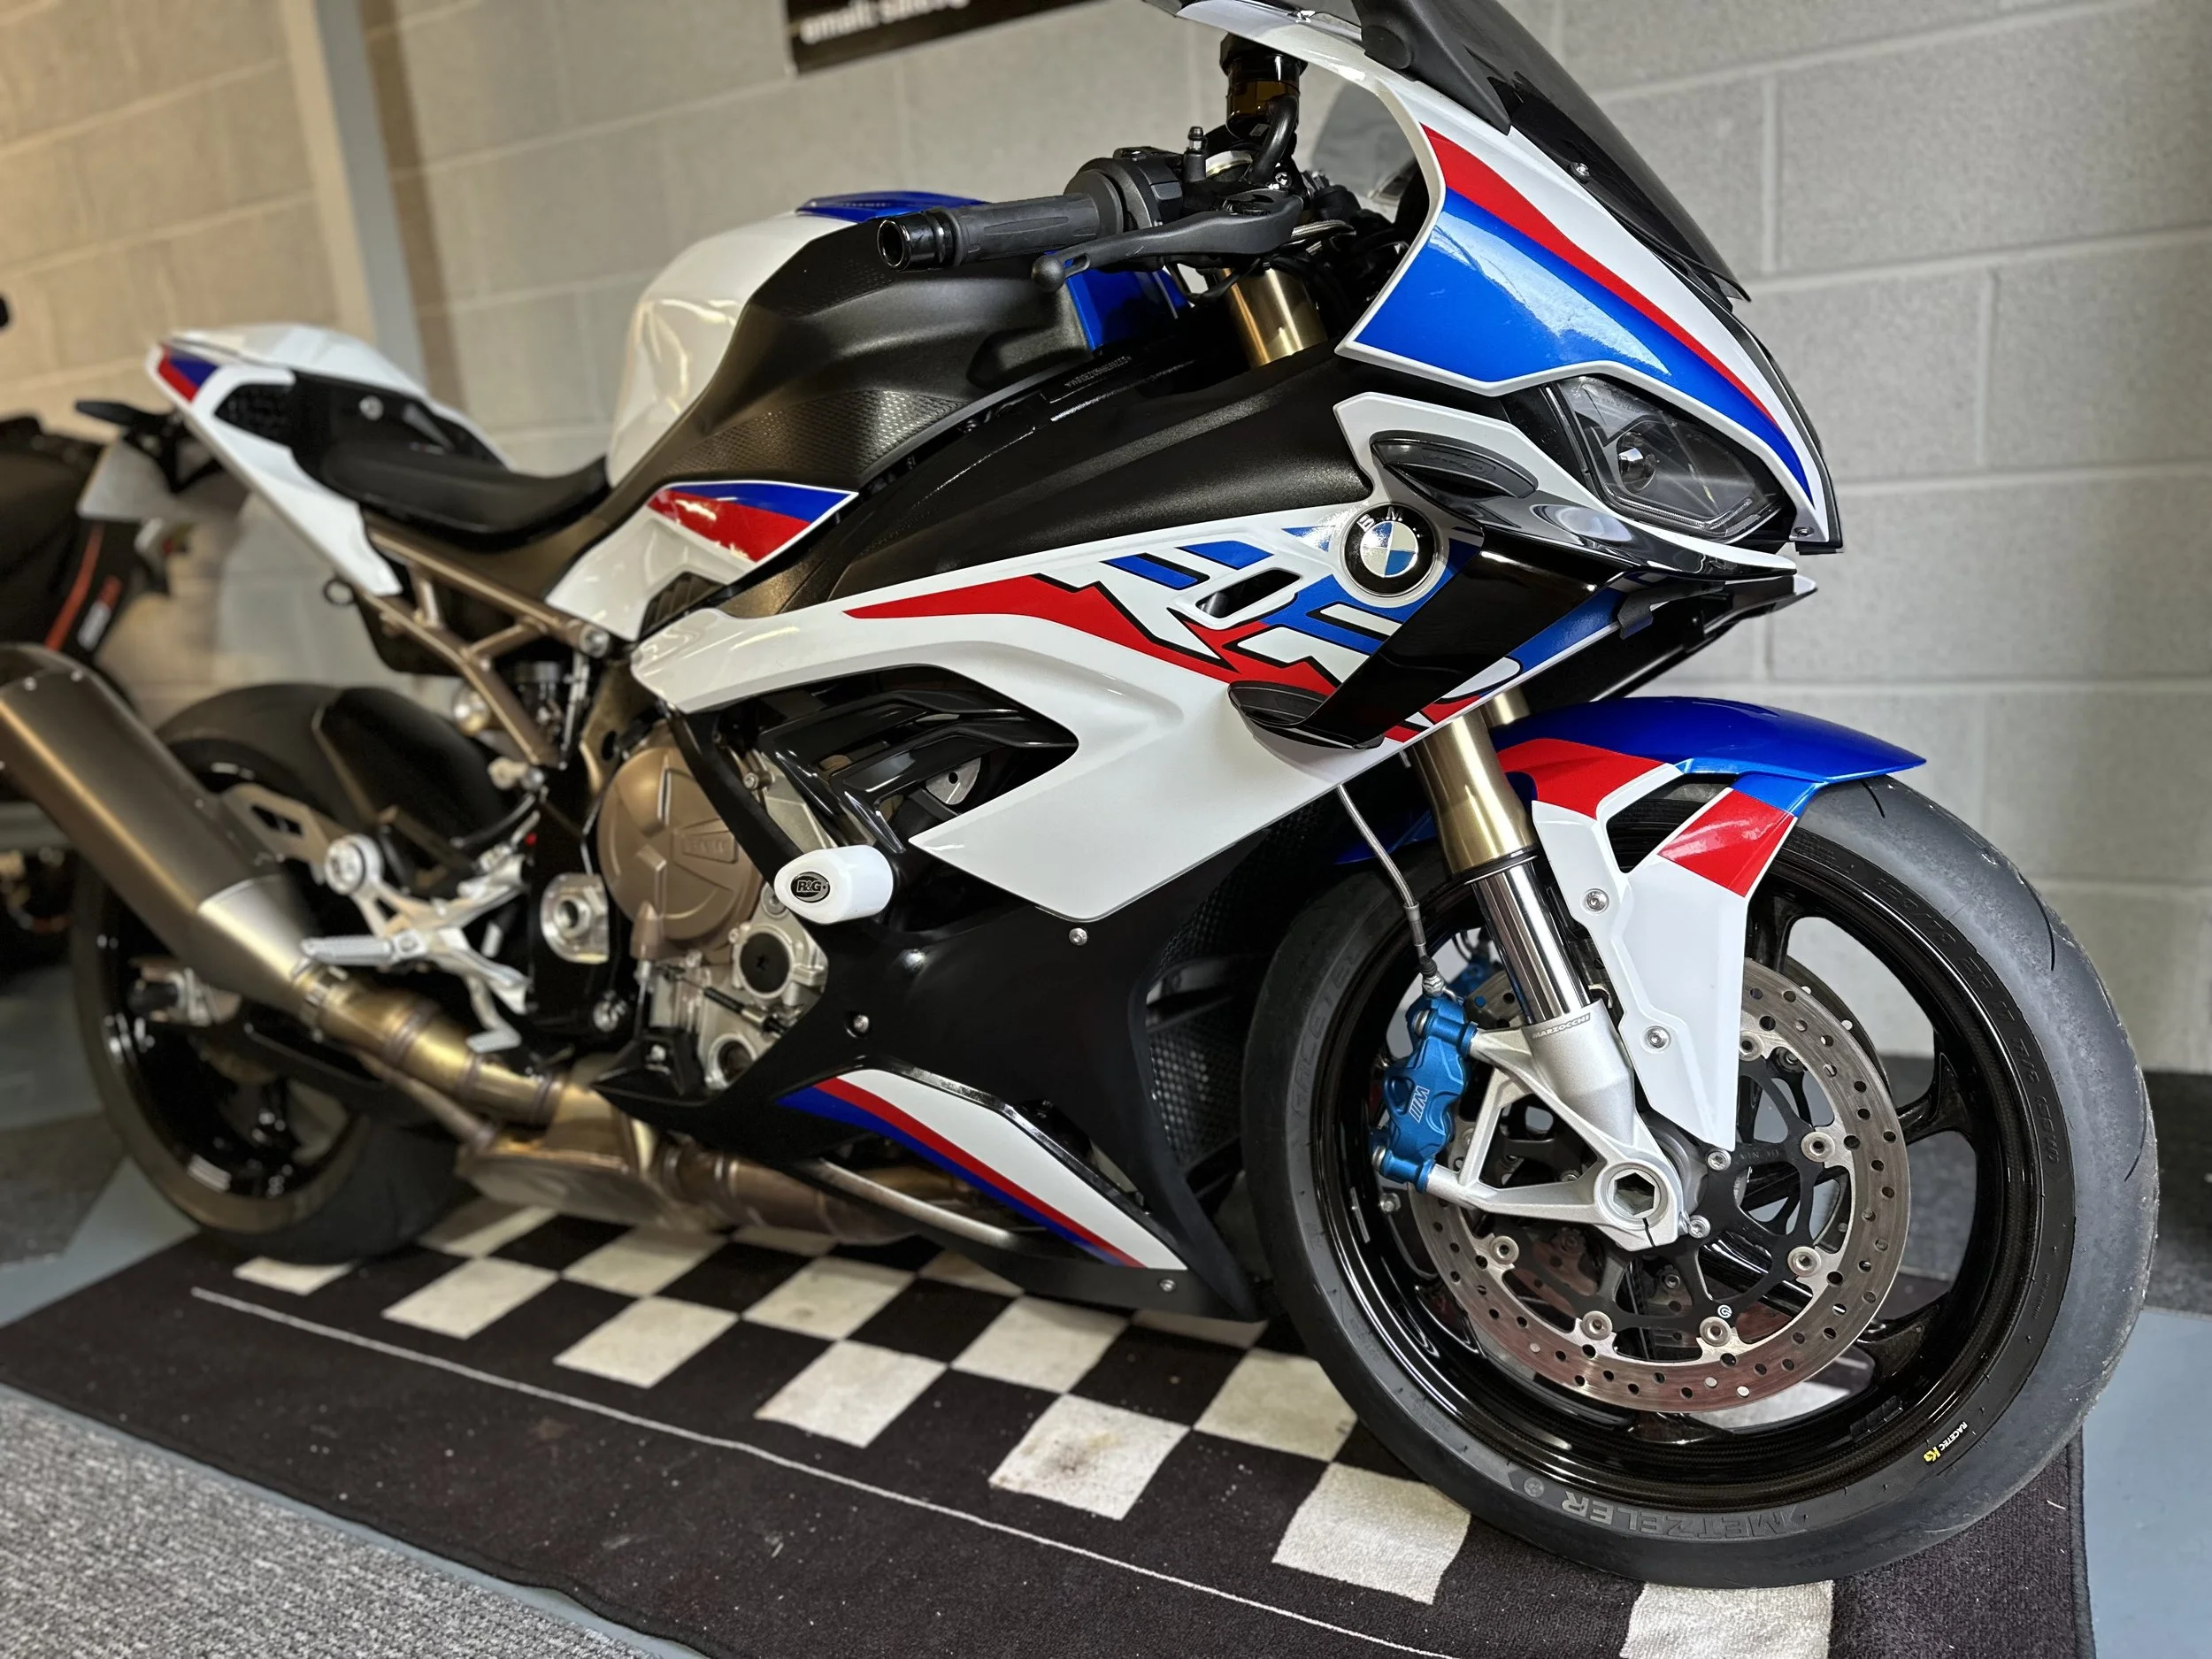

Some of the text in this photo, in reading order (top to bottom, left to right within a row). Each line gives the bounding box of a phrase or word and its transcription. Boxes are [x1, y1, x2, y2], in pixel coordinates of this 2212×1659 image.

[1356, 506, 1423, 538] BM
[797, 880, 822, 893] R&G
[1532, 1012, 1591, 1039] MARZOCCHI
[1938, 1421, 1968, 1451] RACETEC
[1561, 1490, 1787, 1540] METZELER
